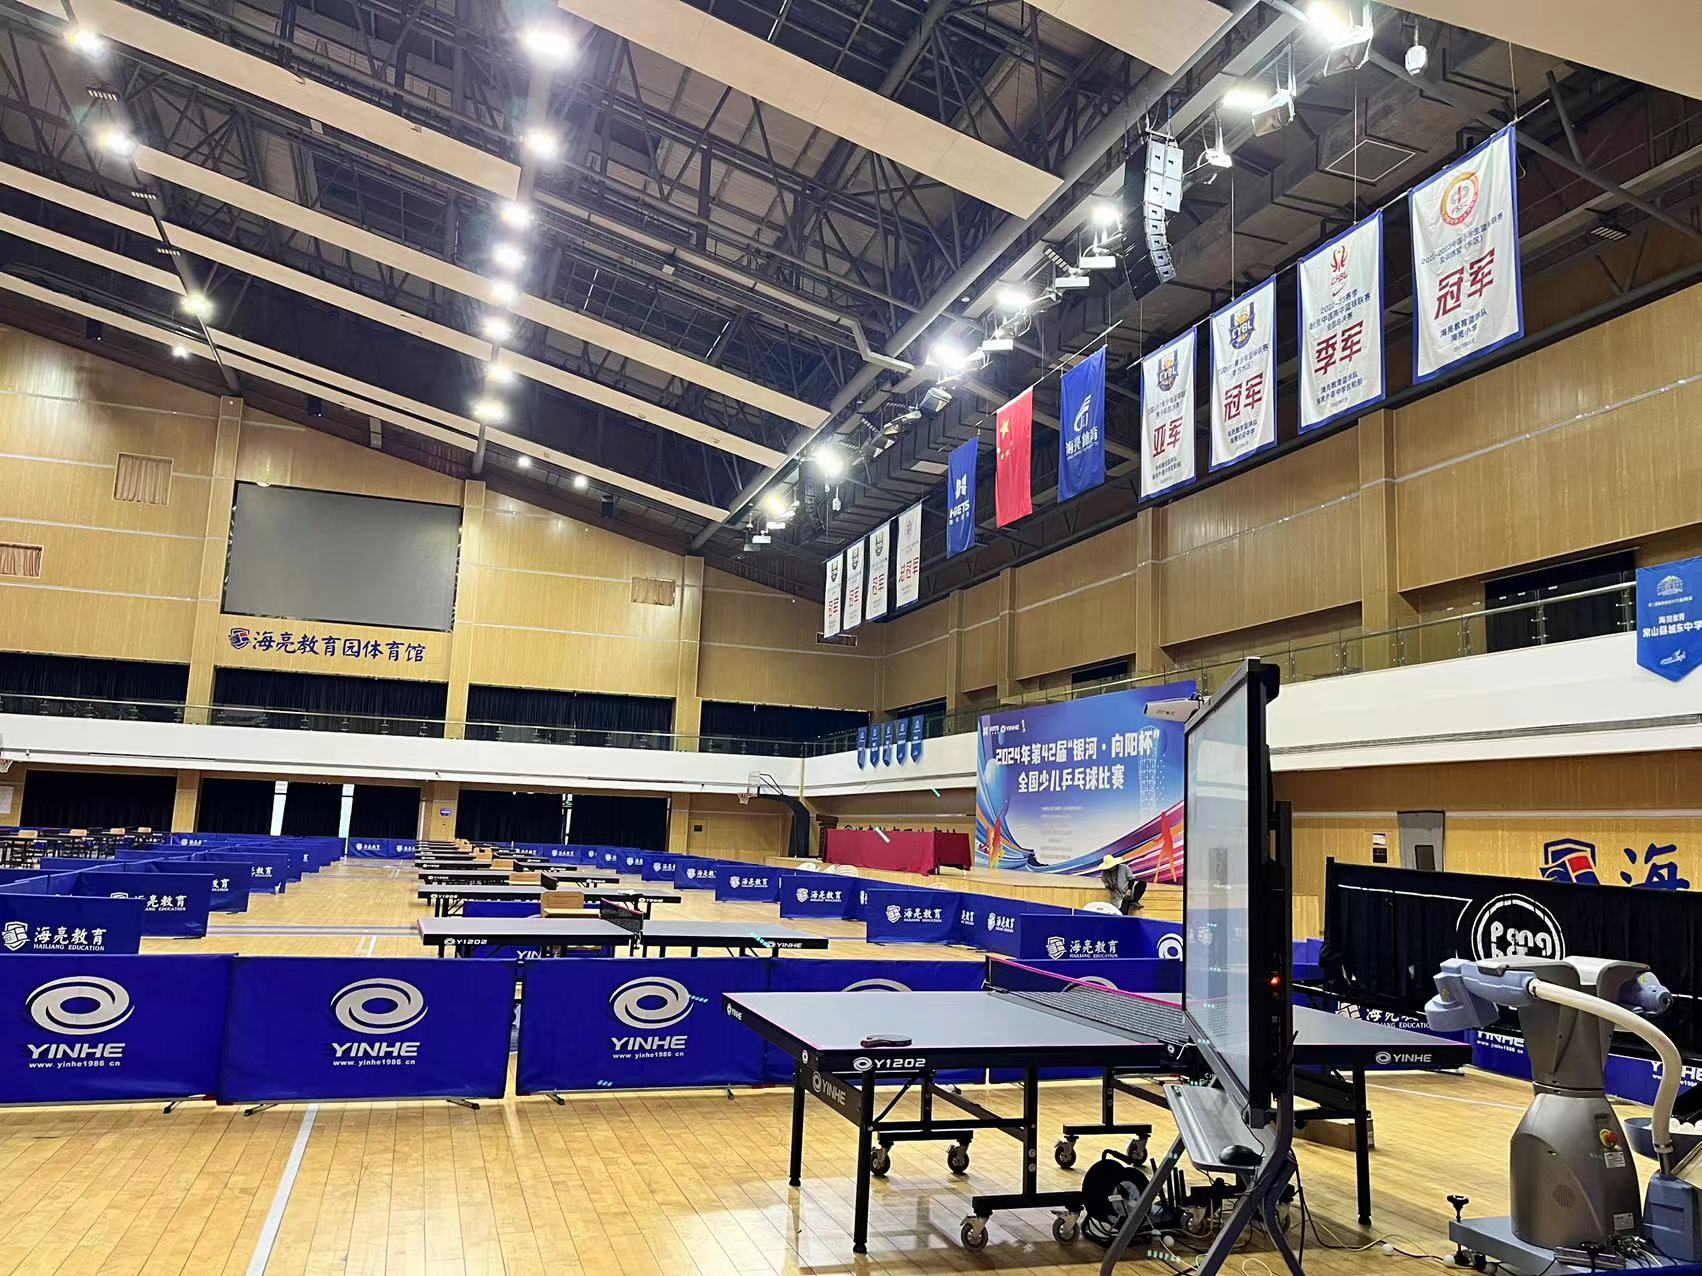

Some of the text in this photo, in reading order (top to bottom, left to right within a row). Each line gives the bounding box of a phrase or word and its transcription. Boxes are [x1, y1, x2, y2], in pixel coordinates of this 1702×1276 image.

[1434, 247, 1496, 320] 冠军
[1232, 320, 1253, 339] CYBL
[1440, 308, 1487, 338] 海亮教育篮球队
[1451, 323, 1478, 343] 海亮小学
[1314, 320, 1364, 375] 季军
[1224, 371, 1264, 422] 冠军
[1065, 424, 1098, 456] 海亮体育
[1153, 415, 1184, 458] 亚军
[1658, 612, 1685, 624] 海亮教育
[252, 630, 426, 662] 海亮教育园体育馆
[1017, 763, 1125, 793] 全国少儿乒乓球比赛
[697, 869, 717, 877] 海亮教
[741, 878, 769, 886] 海亮教育
[809, 890, 843, 900] 海亮教育
[903, 908, 943, 920] 海亮教育
[33, 926, 107, 945] 海亮教育
[1069, 939, 1119, 954] 海亮教育
[731, 1008, 743, 1020] YINHE
[611, 1035, 688, 1050] YINHE
[1477, 1031, 1525, 1048] YINHE
[27, 1043, 126, 1059] YINHE
[331, 1041, 421, 1057] YINHE
[873, 1058, 927, 1068] Y1202
[1393, 1054, 1433, 1063] YINHE
[820, 1079, 846, 1106] YINHE
